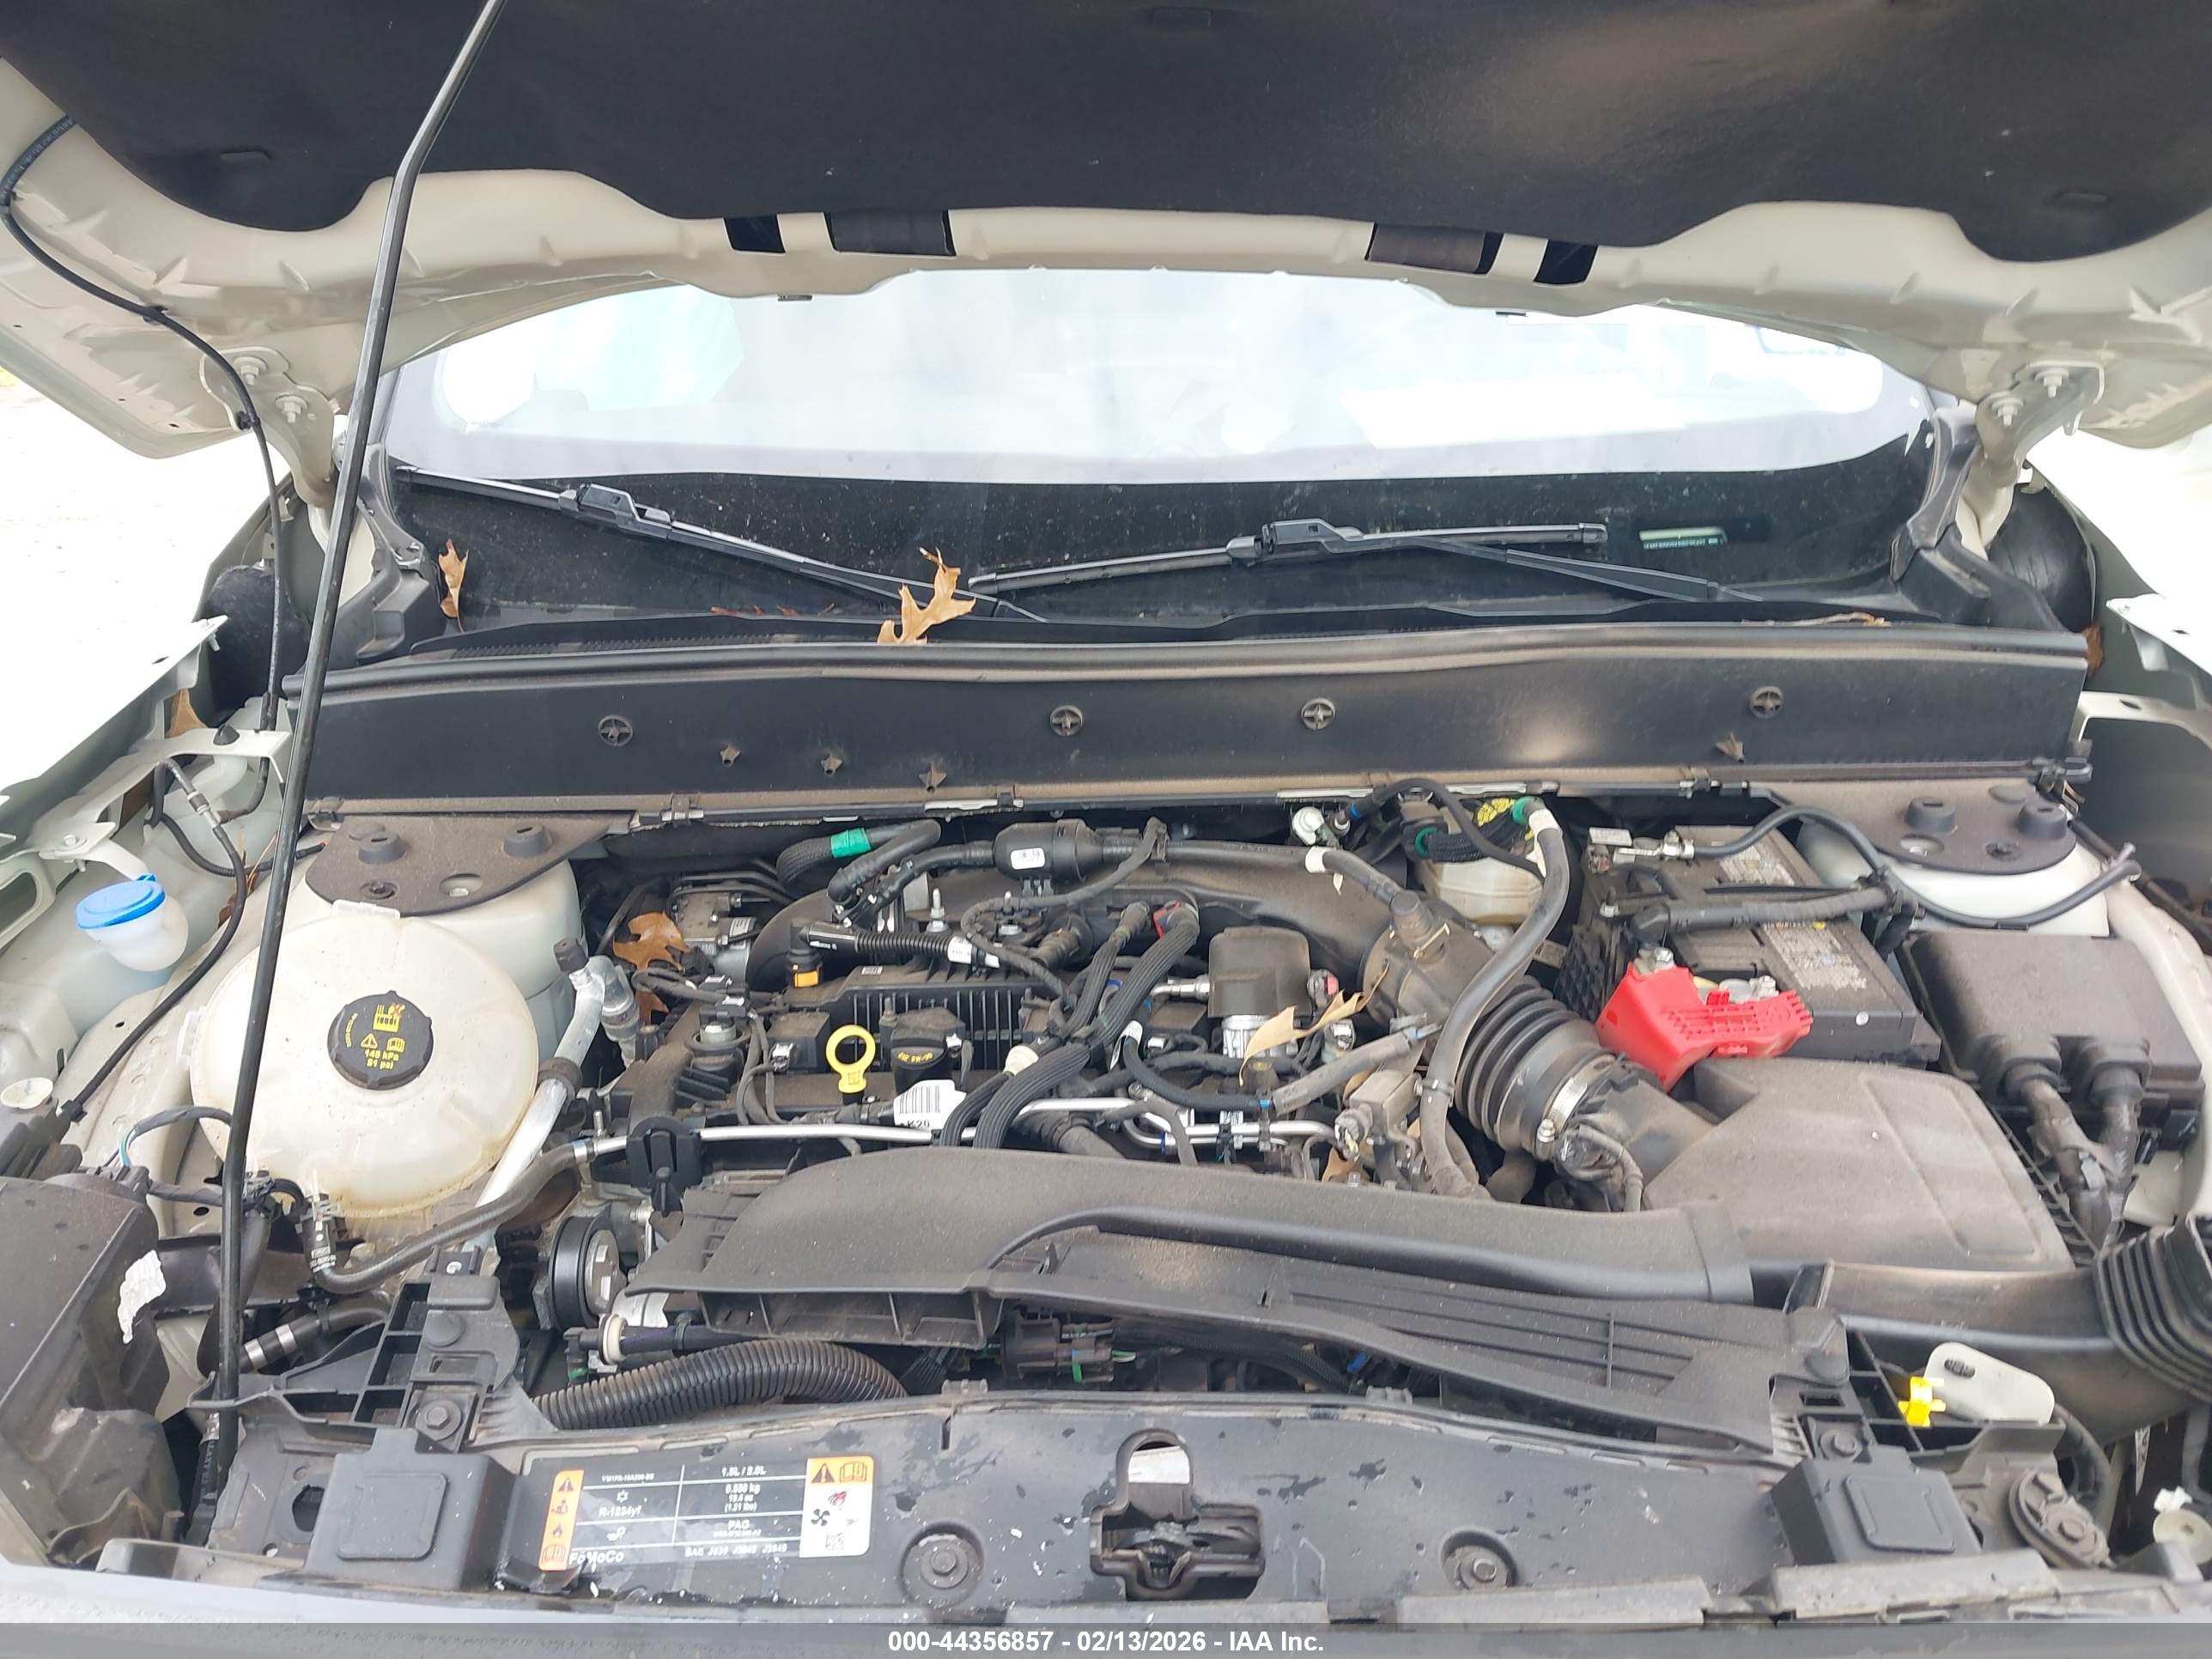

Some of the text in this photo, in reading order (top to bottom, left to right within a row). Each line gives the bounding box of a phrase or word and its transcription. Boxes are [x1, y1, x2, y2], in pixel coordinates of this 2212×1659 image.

[382, 1051, 399, 1060] kPa
[749, 1482, 761, 1495] kg
[599, 1504, 641, 1518] R-1234yf
[727, 1519, 750, 1530] PAG
[568, 1549, 625, 1565] FoMoCo
